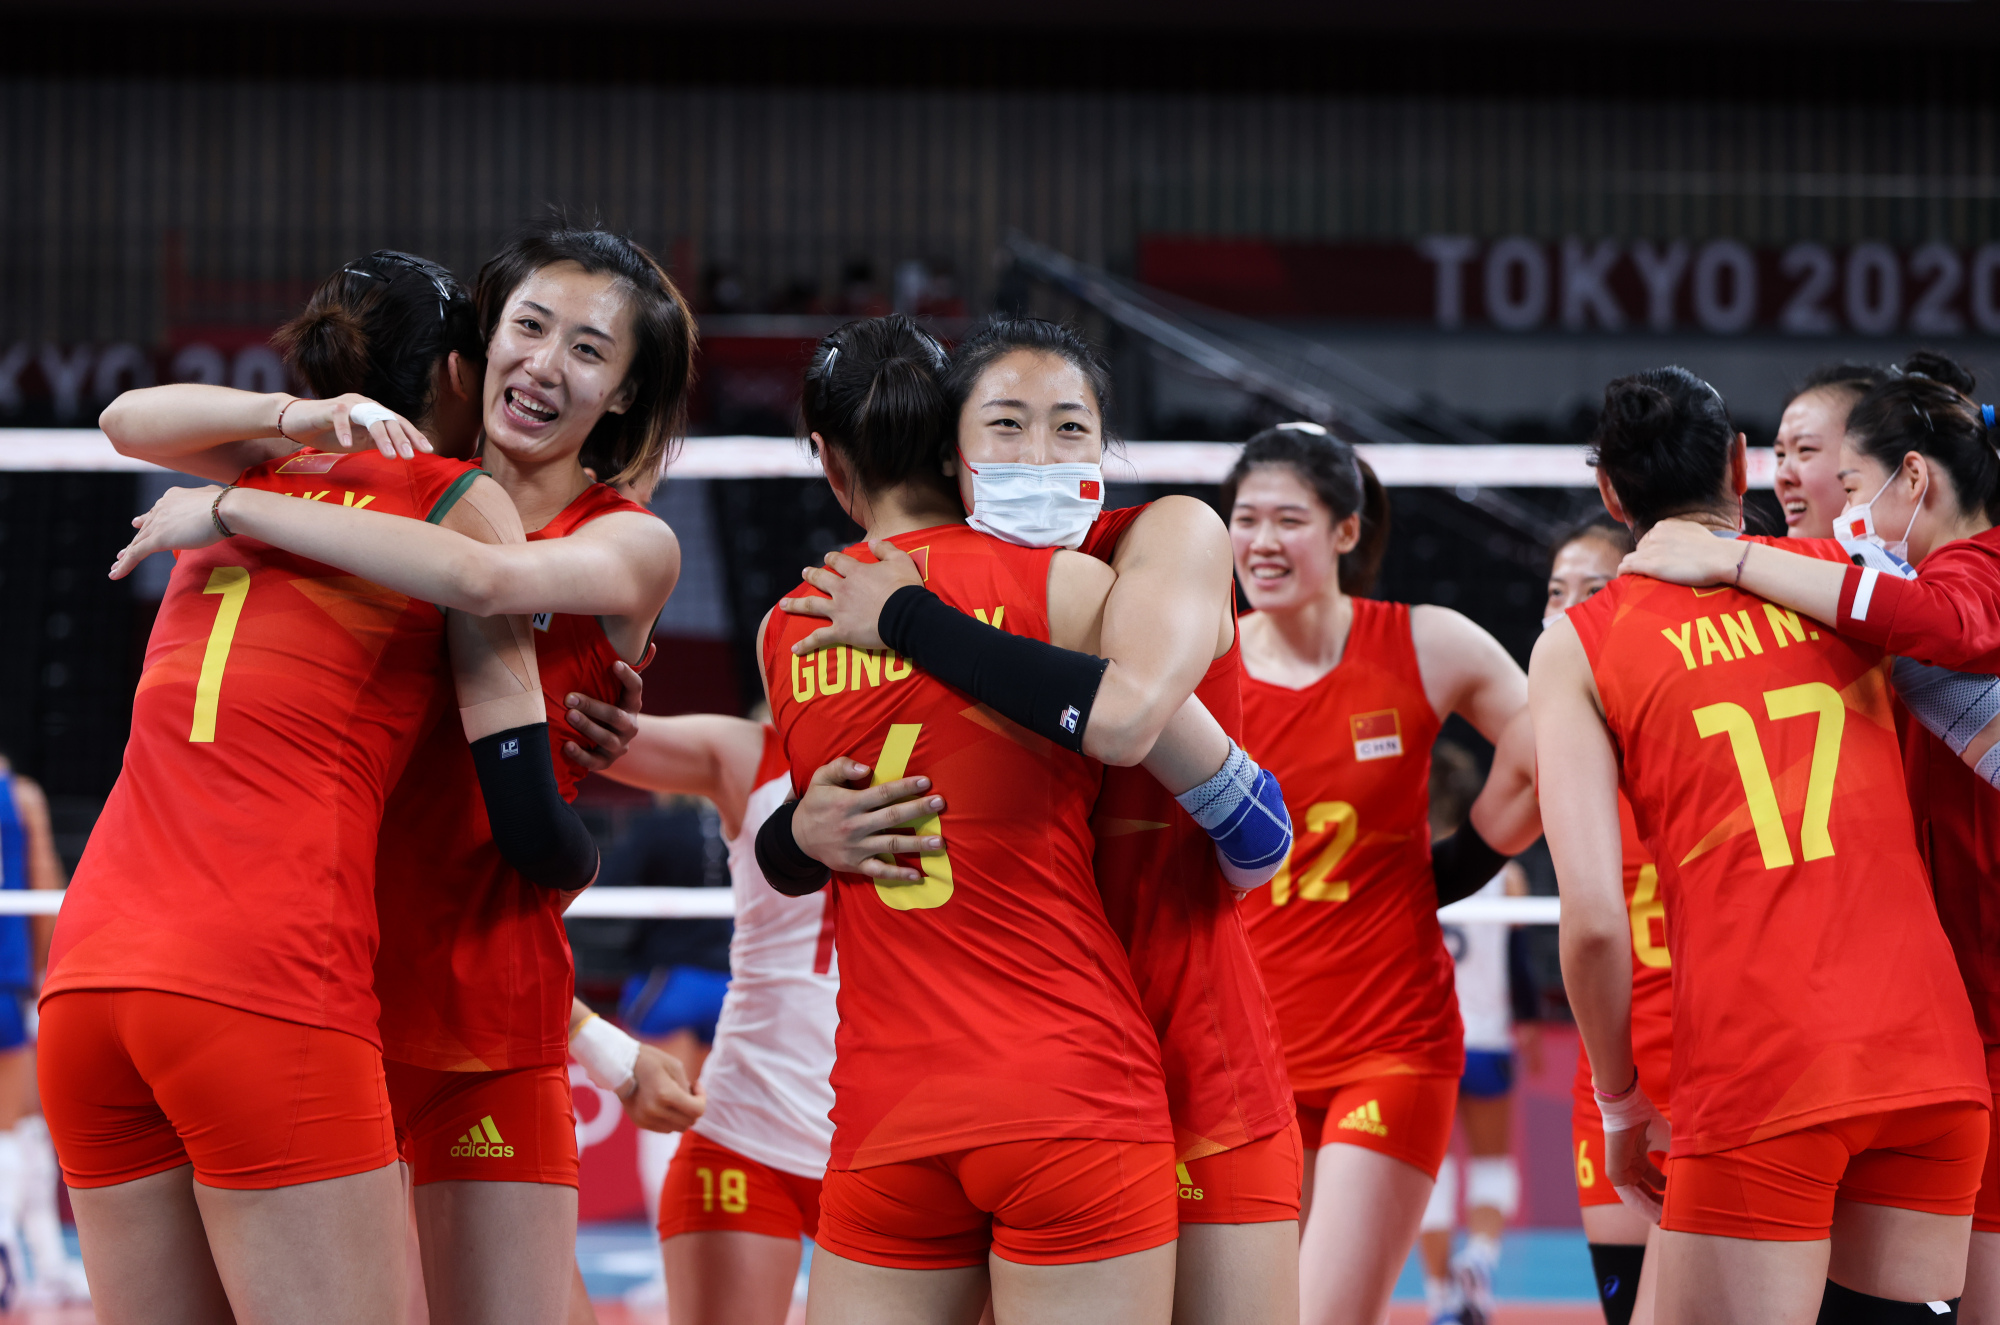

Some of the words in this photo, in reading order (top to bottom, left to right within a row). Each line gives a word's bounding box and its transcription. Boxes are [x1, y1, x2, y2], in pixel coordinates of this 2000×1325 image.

[1419, 235, 1758, 332] TOKYO
[189, 566, 251, 743] 1
[1661, 609, 1764, 671] YAN
[1762, 603, 1820, 648] N.
[869, 723, 955, 911] 6
[1692, 682, 1845, 870] 17
[1629, 862, 1672, 968] 6
[450, 1142, 515, 1157] adidas
[697, 1167, 748, 1214] 18
[1577, 1139, 1595, 1188] 6
